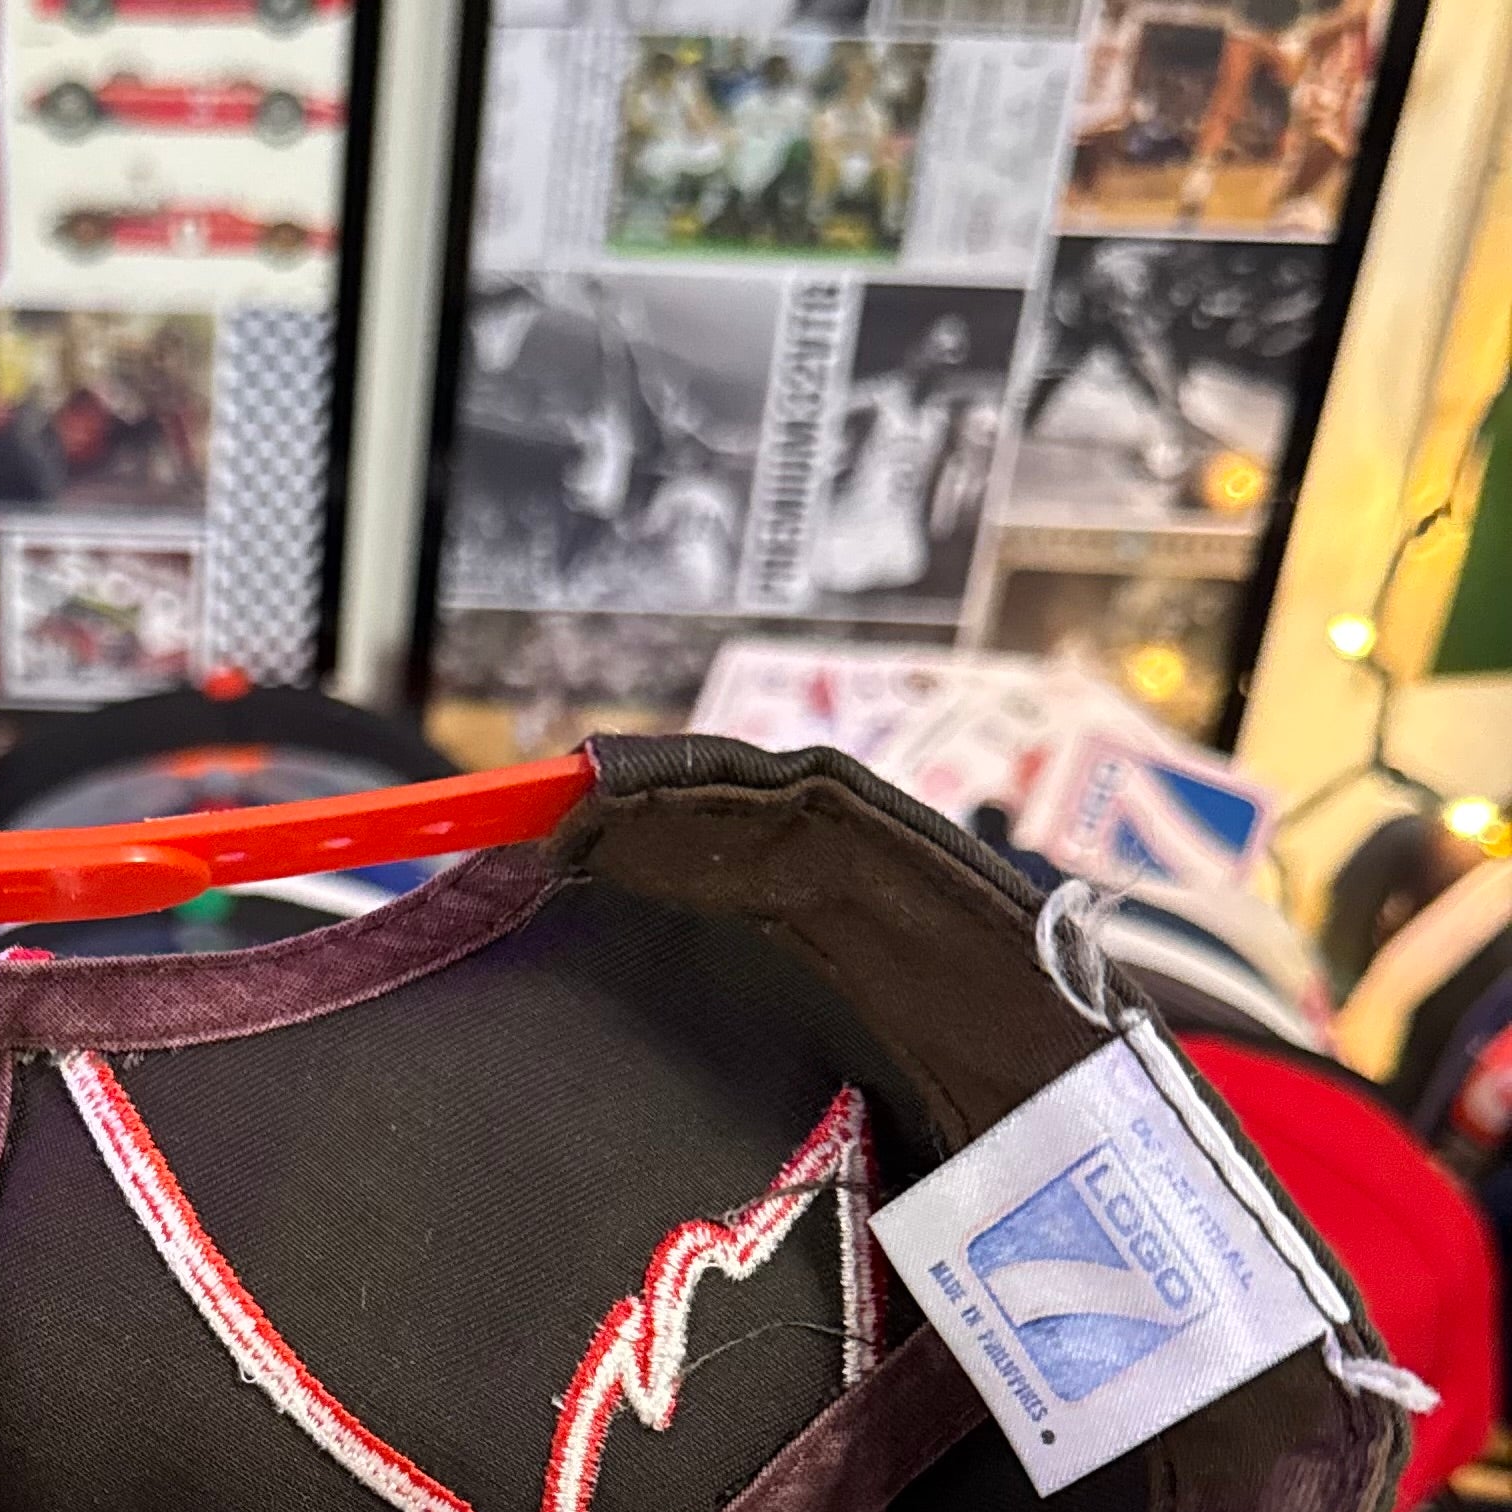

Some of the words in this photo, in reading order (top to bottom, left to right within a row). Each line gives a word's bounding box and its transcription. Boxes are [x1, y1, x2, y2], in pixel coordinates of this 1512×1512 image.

[1085, 1164, 1194, 1312] LOGO
[928, 1259, 967, 1304] MADE
[960, 1305, 983, 1327] IN
[975, 1328, 1050, 1424] PHILIPPINES
